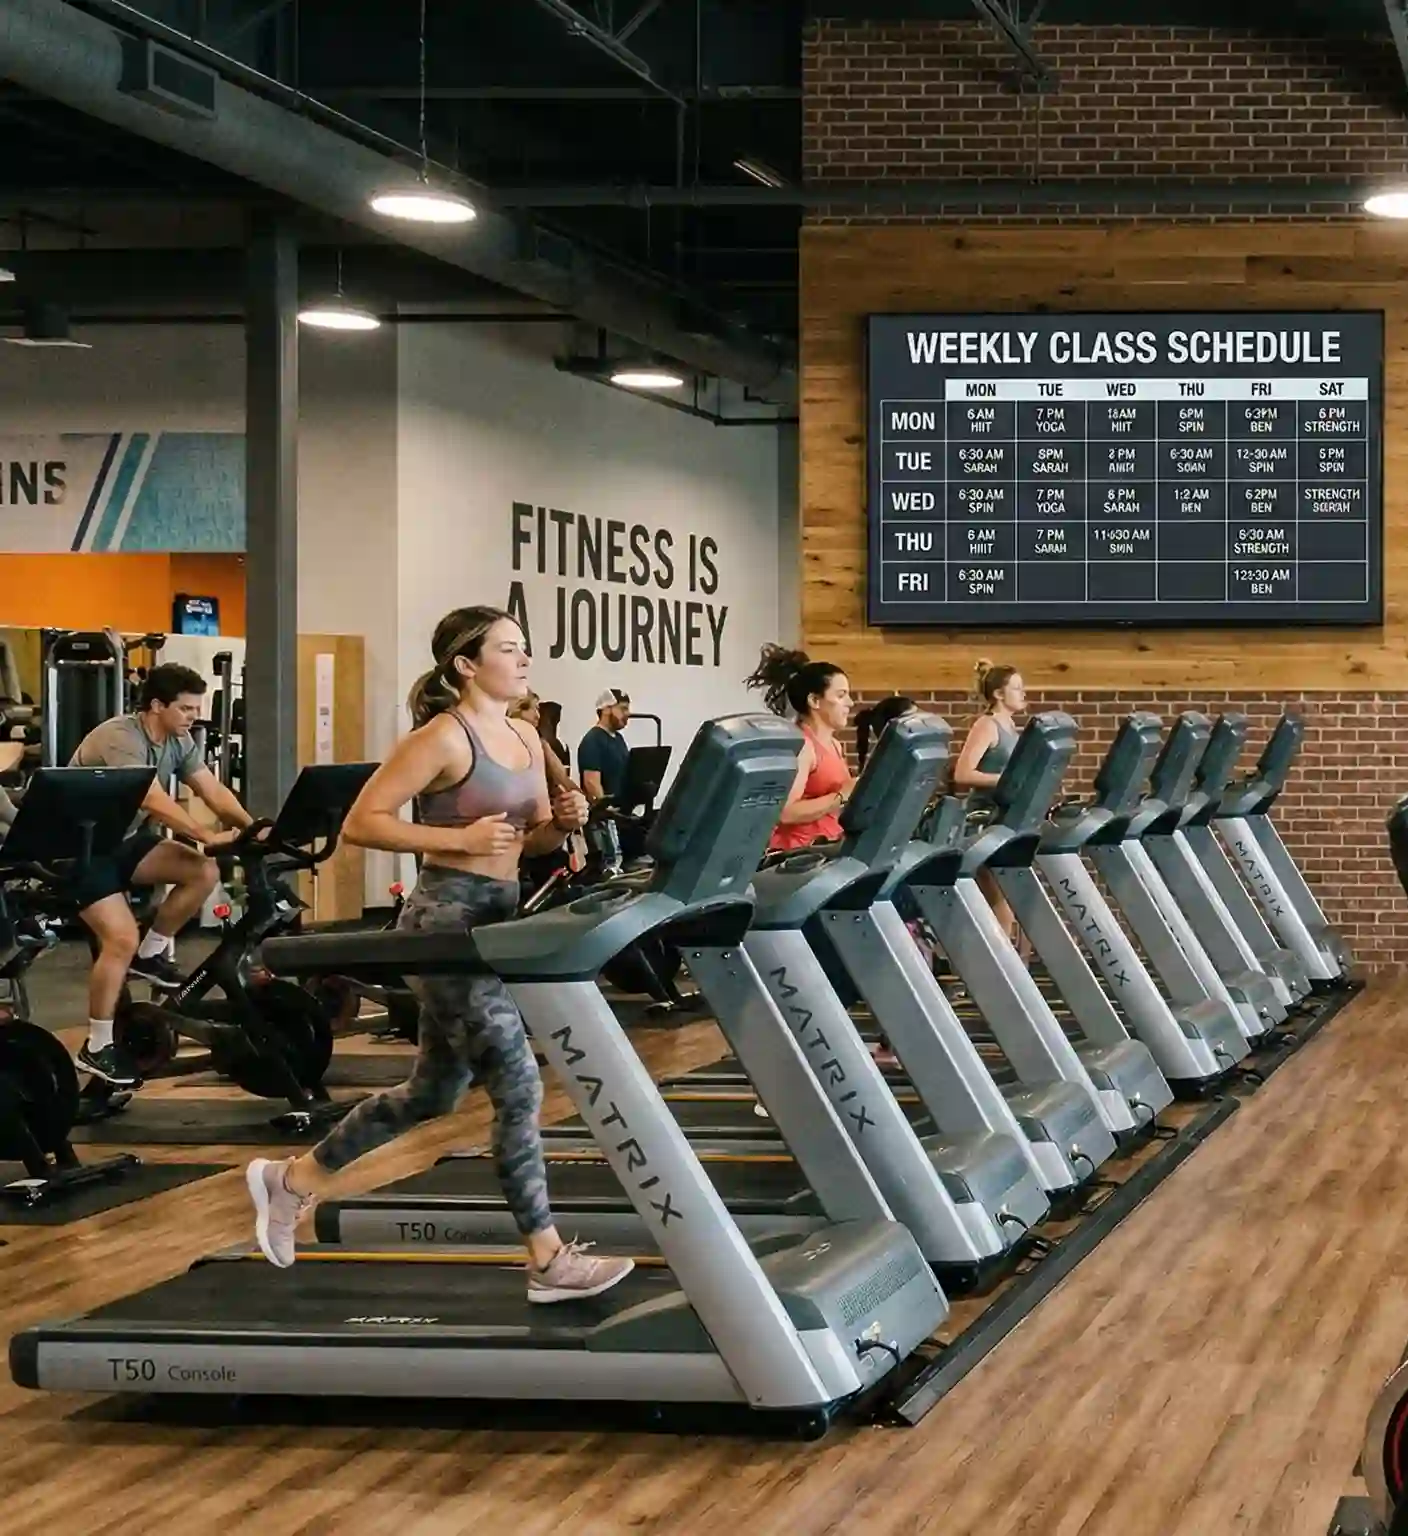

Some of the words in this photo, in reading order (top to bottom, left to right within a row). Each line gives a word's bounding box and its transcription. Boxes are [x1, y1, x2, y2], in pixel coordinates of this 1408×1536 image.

[908, 331, 1038, 364] WEEKLY
[1050, 331, 1157, 364] CLASS
[1168, 331, 1341, 363] SCHEDULE
[966, 384, 996, 396] MON
[1038, 384, 1063, 396] TUE
[1106, 383, 1136, 396] WED
[1179, 383, 1204, 396] THU
[1252, 383, 1272, 396] FRI
[1320, 383, 1344, 395] SAT
[1037, 409, 1043, 418] 7
[1047, 409, 1064, 419] PM
[891, 412, 935, 430] MON
[1036, 422, 1066, 432] YOGA
[1179, 422, 1204, 432] SPIN
[1251, 422, 1272, 432] BEN
[1305, 422, 1360, 432] STRENGTH
[986, 449, 1003, 459] AM
[1118, 449, 1135, 459] PM
[1196, 449, 1212, 459] AM
[1270, 449, 1286, 458] AM
[1328, 449, 1344, 458] PM
[896, 453, 931, 470] TUE
[964, 463, 998, 473] SARAH
[1032, 463, 1068, 473] SARAH
[1249, 462, 1274, 472] SPIN
[0, 461, 67, 505] NS
[986, 489, 1003, 499] AM
[1037, 489, 1043, 499] 7
[1047, 489, 1064, 499] PM
[1118, 489, 1135, 499] PM
[1192, 489, 1209, 499] AM
[892, 493, 935, 511] WED
[1251, 502, 1272, 512] BEN
[969, 503, 994, 513] SPIN
[1036, 503, 1066, 512] YOGA
[968, 530, 975, 540] 6
[977, 530, 995, 540] AM
[1037, 530, 1043, 540] 7
[1047, 530, 1064, 540] PM
[1132, 530, 1150, 540] AM
[1266, 530, 1284, 539] AM
[895, 533, 933, 551] THU
[512, 500, 674, 589] FITNESS
[689, 534, 719, 595] IS
[1234, 543, 1289, 554] STRENGTH
[986, 570, 1003, 580] AM
[1271, 570, 1290, 580] AM
[898, 573, 928, 591] FRI
[969, 583, 994, 594] SPIN
[1251, 584, 1272, 594] BEN
[507, 581, 533, 658] A
[549, 586, 729, 667] JOURNEY
[1059, 879, 1131, 987] MATRIX
[770, 966, 876, 1132] MATRIX
[549, 1025, 683, 1228] MATRIX
[396, 1222, 436, 1242] T50
[107, 1358, 156, 1381] T50
[167, 1365, 237, 1382] Console
